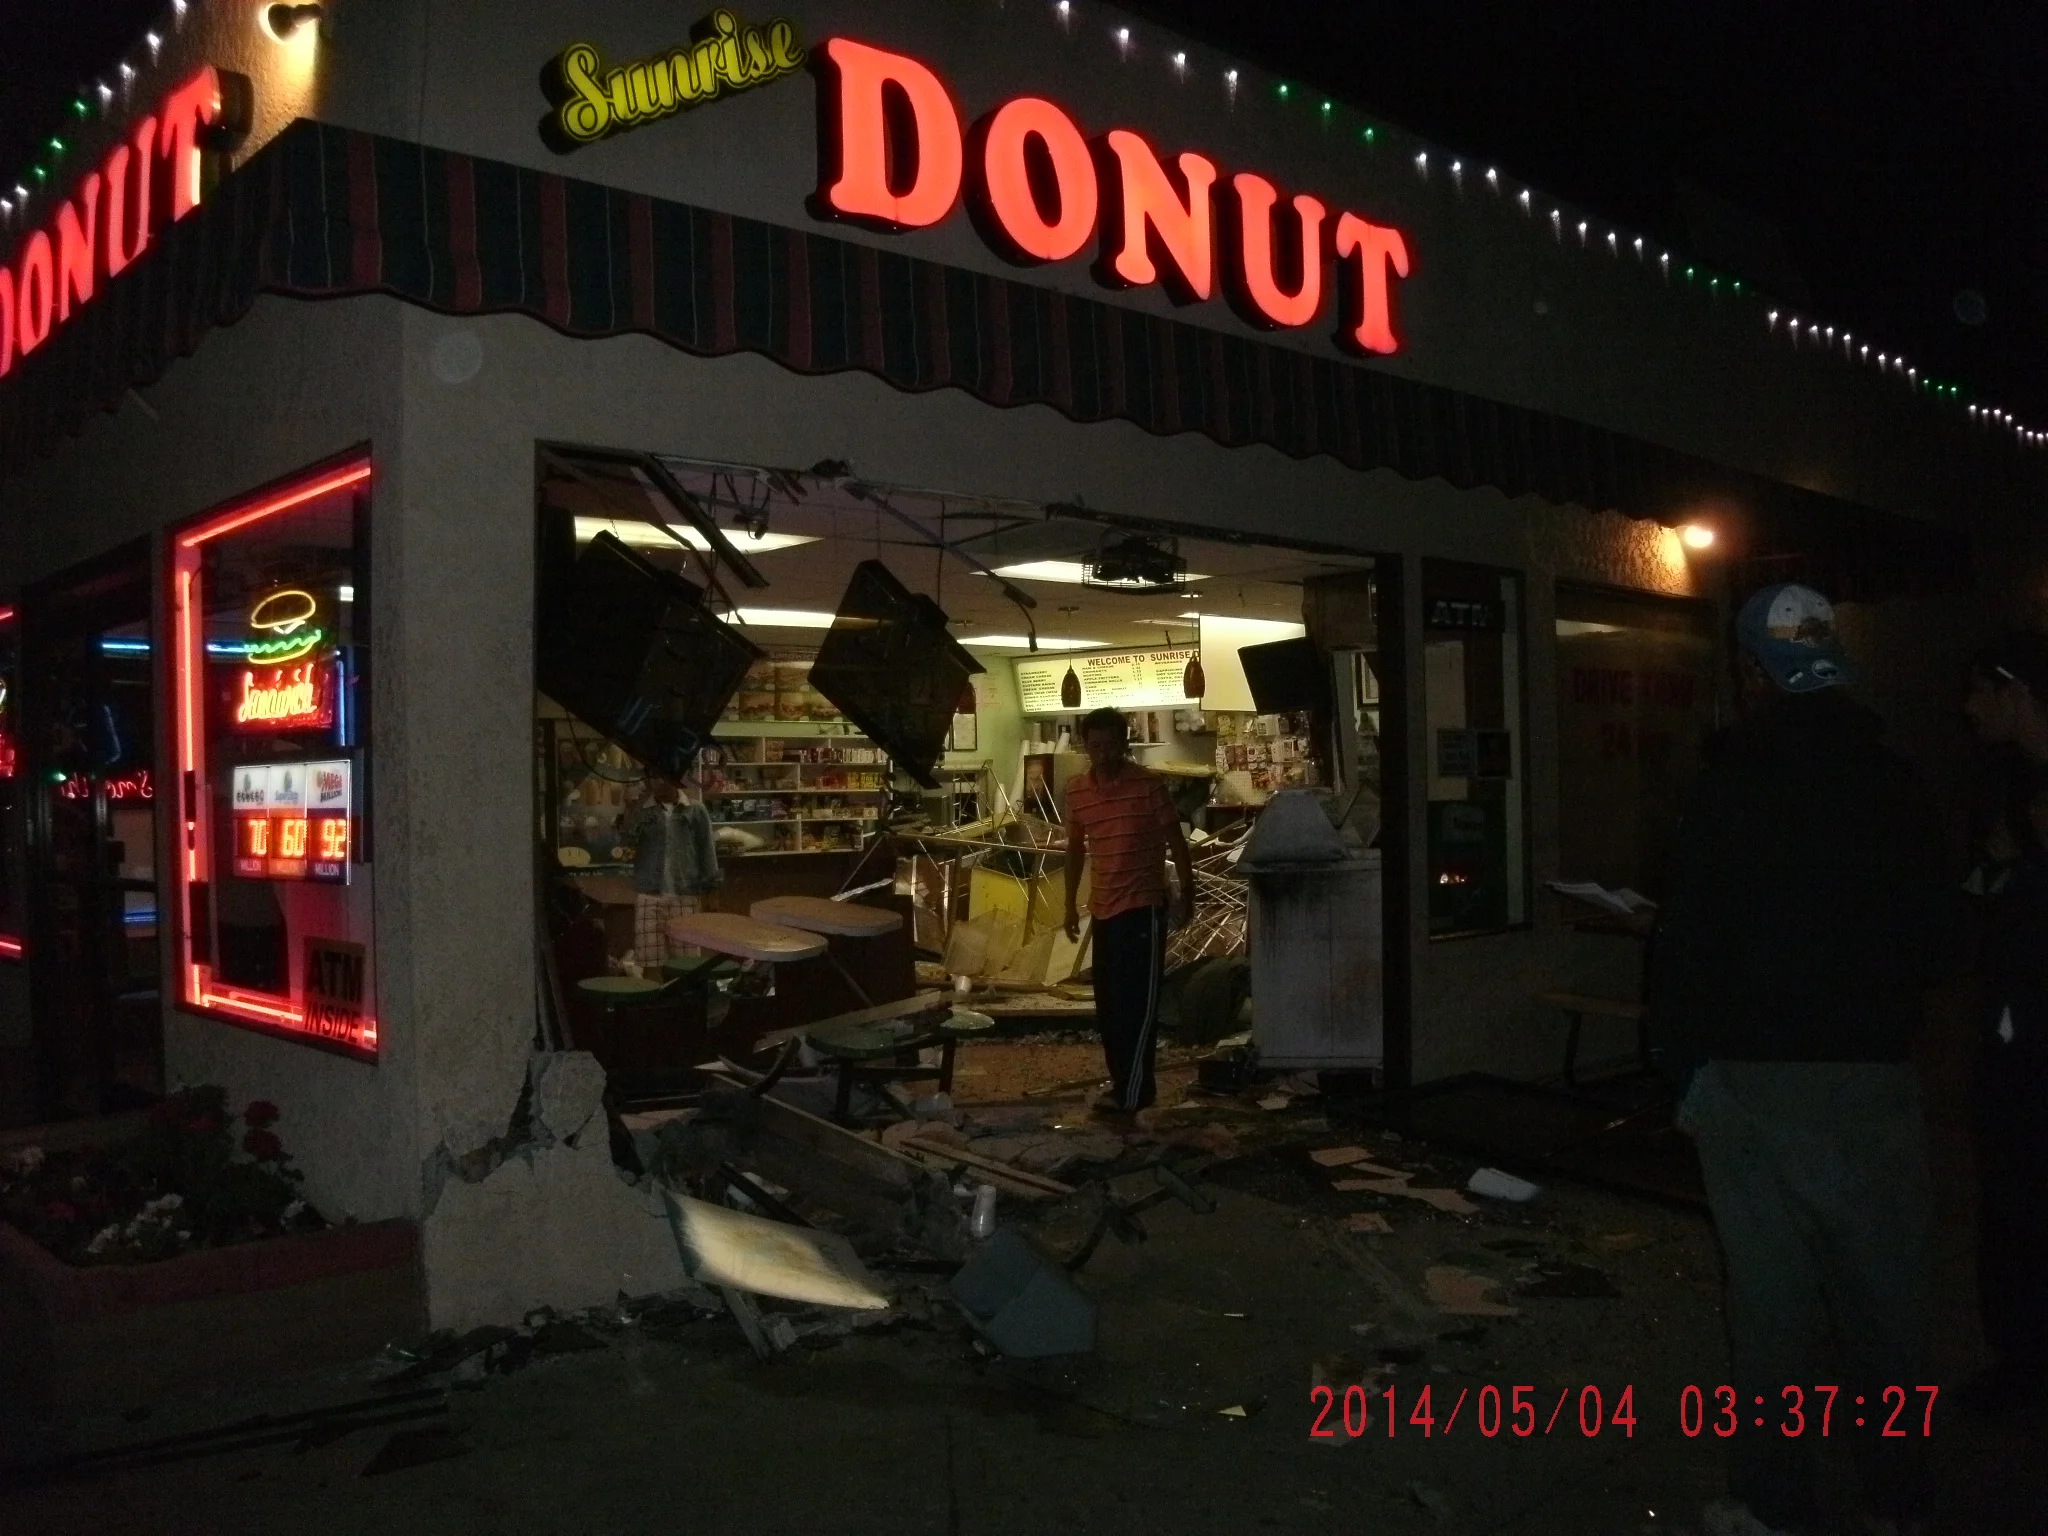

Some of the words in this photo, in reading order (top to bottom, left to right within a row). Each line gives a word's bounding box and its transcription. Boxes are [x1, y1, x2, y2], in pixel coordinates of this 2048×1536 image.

[563, 10, 807, 140] Sunrise
[828, 38, 1410, 354] DONUT
[1431, 600, 1488, 627] ATM
[1088, 656, 1131, 666] WELCOME
[1133, 654, 1145, 663] TO
[1150, 651, 1191, 661] SUNRISE
[249, 820, 267, 855] 70
[283, 819, 307, 856] 60
[322, 819, 346, 858] 92
[304, 948, 362, 1004] ATM
[303, 1001, 360, 1043] INSIDE
